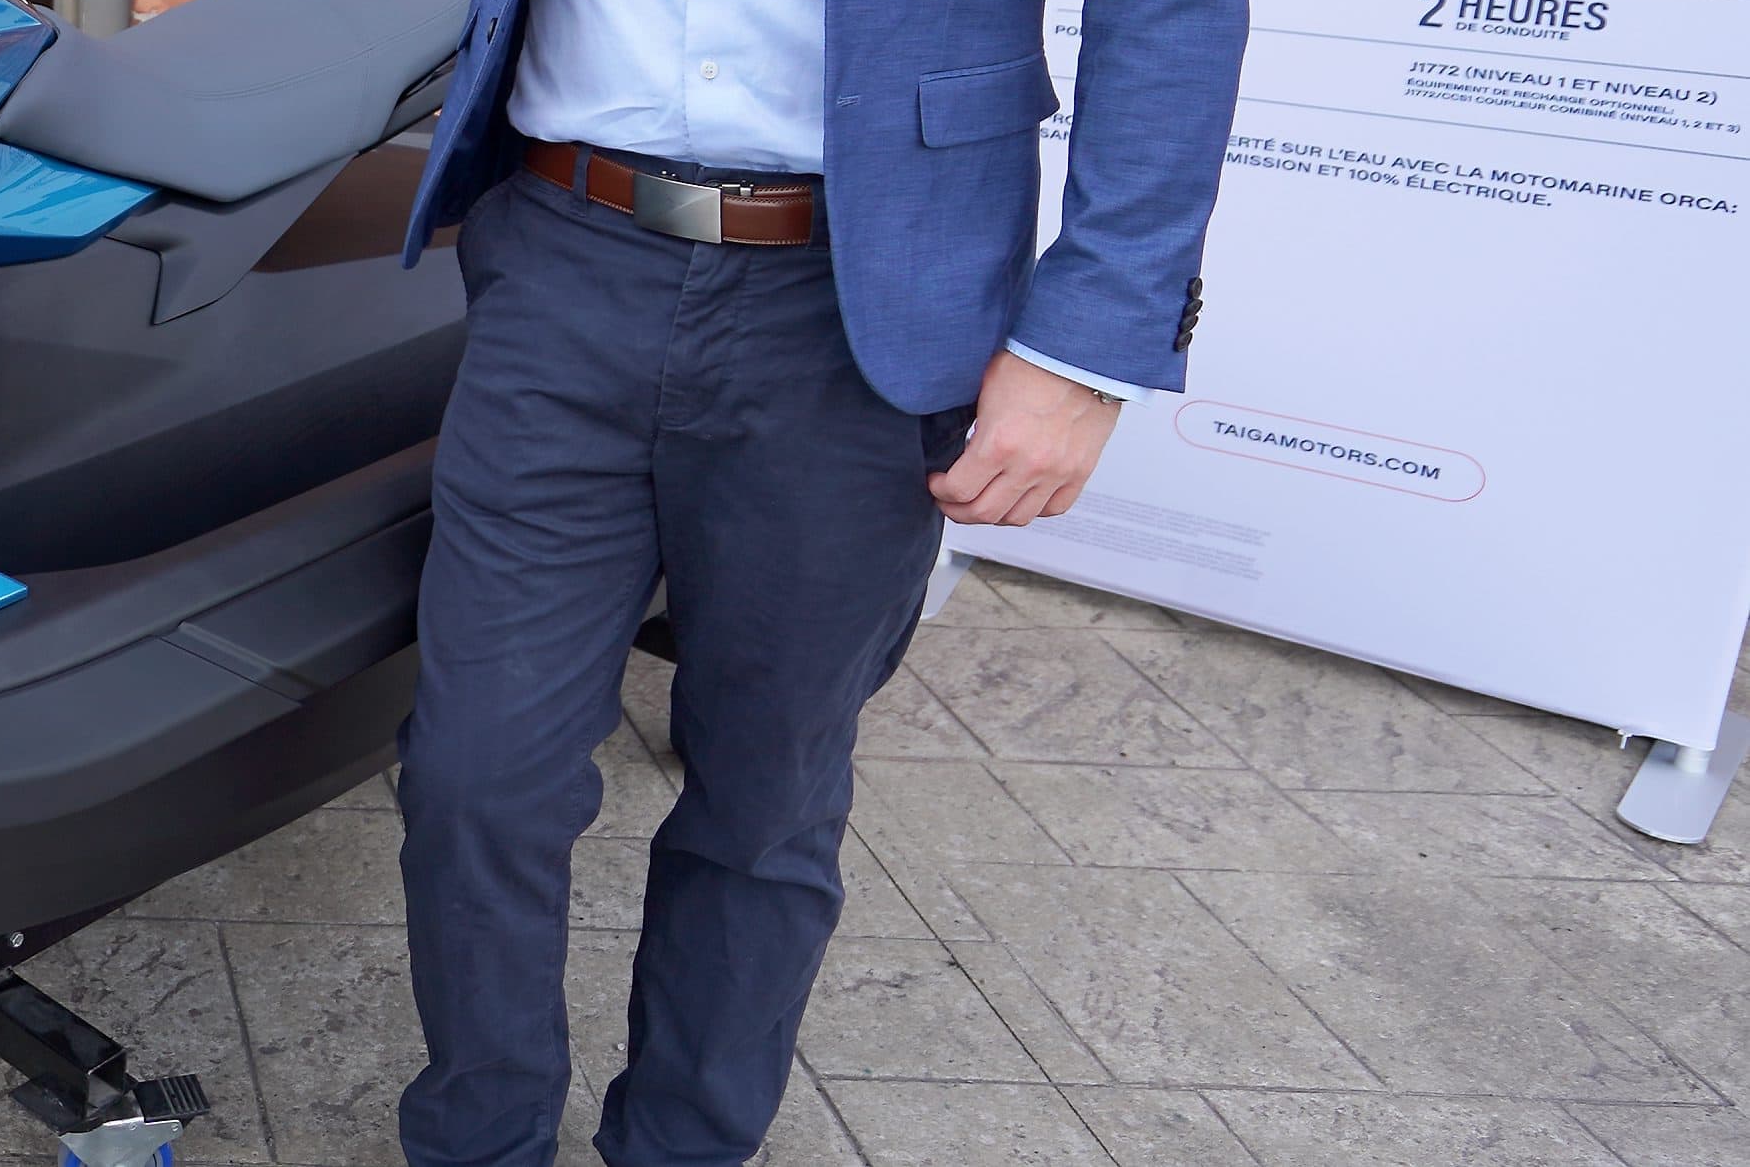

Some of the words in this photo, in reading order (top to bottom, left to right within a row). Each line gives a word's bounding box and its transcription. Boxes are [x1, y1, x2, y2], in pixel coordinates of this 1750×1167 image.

[1455, 21, 1478, 32] DE
[1482, 23, 1571, 41] CONDUITE
[1409, 61, 1461, 77] J1772
[1464, 65, 1553, 86] (NIVEAU
[1557, 76, 1567, 89] 1
[1572, 77, 1600, 91] ET
[1604, 81, 1691, 101] NIVEAU
[1696, 90, 1718, 106] 2)
[1492, 87, 1511, 97] DE
[1475, 95, 1546, 111] COUPLEUR
[1705, 121, 1725, 131] ET
[1226, 151, 1312, 174] MISSION
[1316, 163, 1344, 178] ET
[1348, 167, 1401, 186] 100%
[1405, 173, 1553, 208] ÉLECTRIQUE.
[1280, 141, 1323, 159] SUR
[1328, 147, 1387, 166] L'EAU
[1390, 156, 1450, 175] AVEC
[1455, 164, 1484, 179] LA
[1490, 168, 1654, 203] MOTOMARINE
[1659, 191, 1739, 215] ORCA:
[1213, 420, 1442, 480] TAIGAMOTORS.COM
